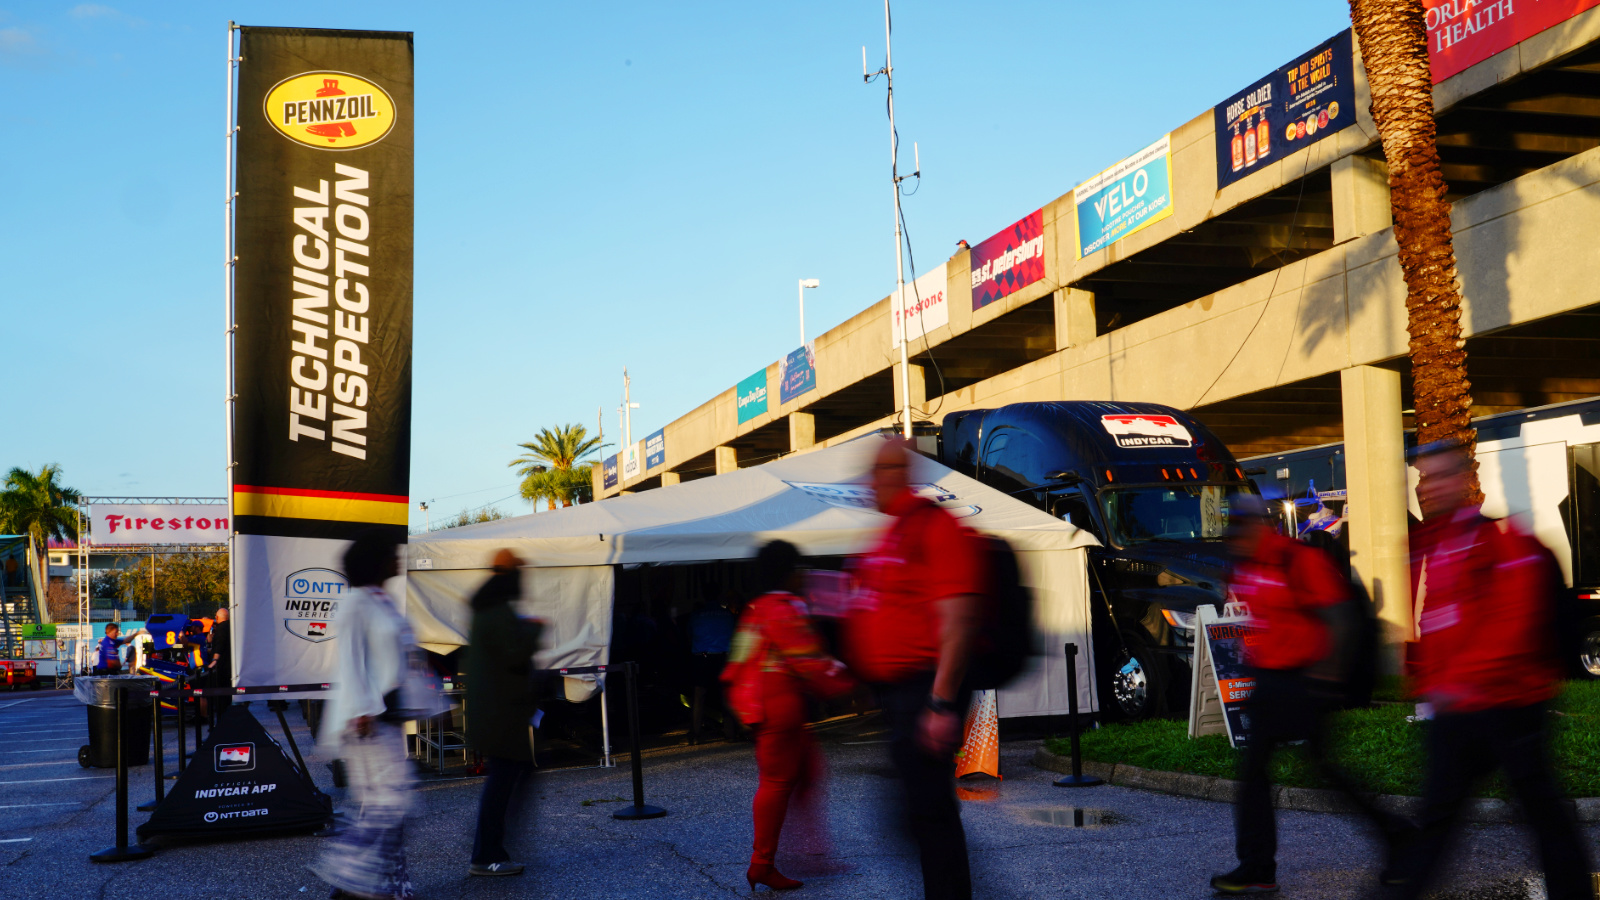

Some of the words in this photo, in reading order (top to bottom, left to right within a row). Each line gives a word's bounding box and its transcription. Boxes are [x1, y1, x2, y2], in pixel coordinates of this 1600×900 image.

[1424, 0, 1483, 31] ORLA
[1435, 0, 1515, 53] HEALTH
[1287, 67, 1299, 84] TOP
[1310, 48, 1333, 71] SPIRITS
[1290, 81, 1297, 96] IN
[1297, 75, 1309, 92] THE
[1309, 63, 1331, 85] WORLD
[283, 95, 377, 125] PENNZOIL
[1226, 98, 1245, 124] HORSE
[1246, 82, 1272, 109] SOLDIER
[1093, 168, 1148, 223] VELO
[1122, 200, 1145, 219] POUCHES
[1083, 232, 1110, 256] DISCOVER
[1110, 220, 1127, 238] MORE
[1127, 215, 1135, 226] AT
[1135, 207, 1148, 221] OUR
[1148, 194, 1166, 212] KIOSK
[289, 178, 329, 442] TECHNICAL
[331, 162, 370, 460] INSPECTION
[1120, 437, 1174, 446] INDYCAR
[104, 514, 229, 534] Fireston
[311, 581, 345, 594] NTT
[285, 599, 339, 612] INDYCA
[297, 611, 336, 619] SERIES
[165, 631, 176, 645] 8
[1229, 689, 1255, 700] SERV
[194, 786, 250, 799] INDYCAR
[251, 783, 277, 794] APP
[220, 811, 241, 819] NTT
